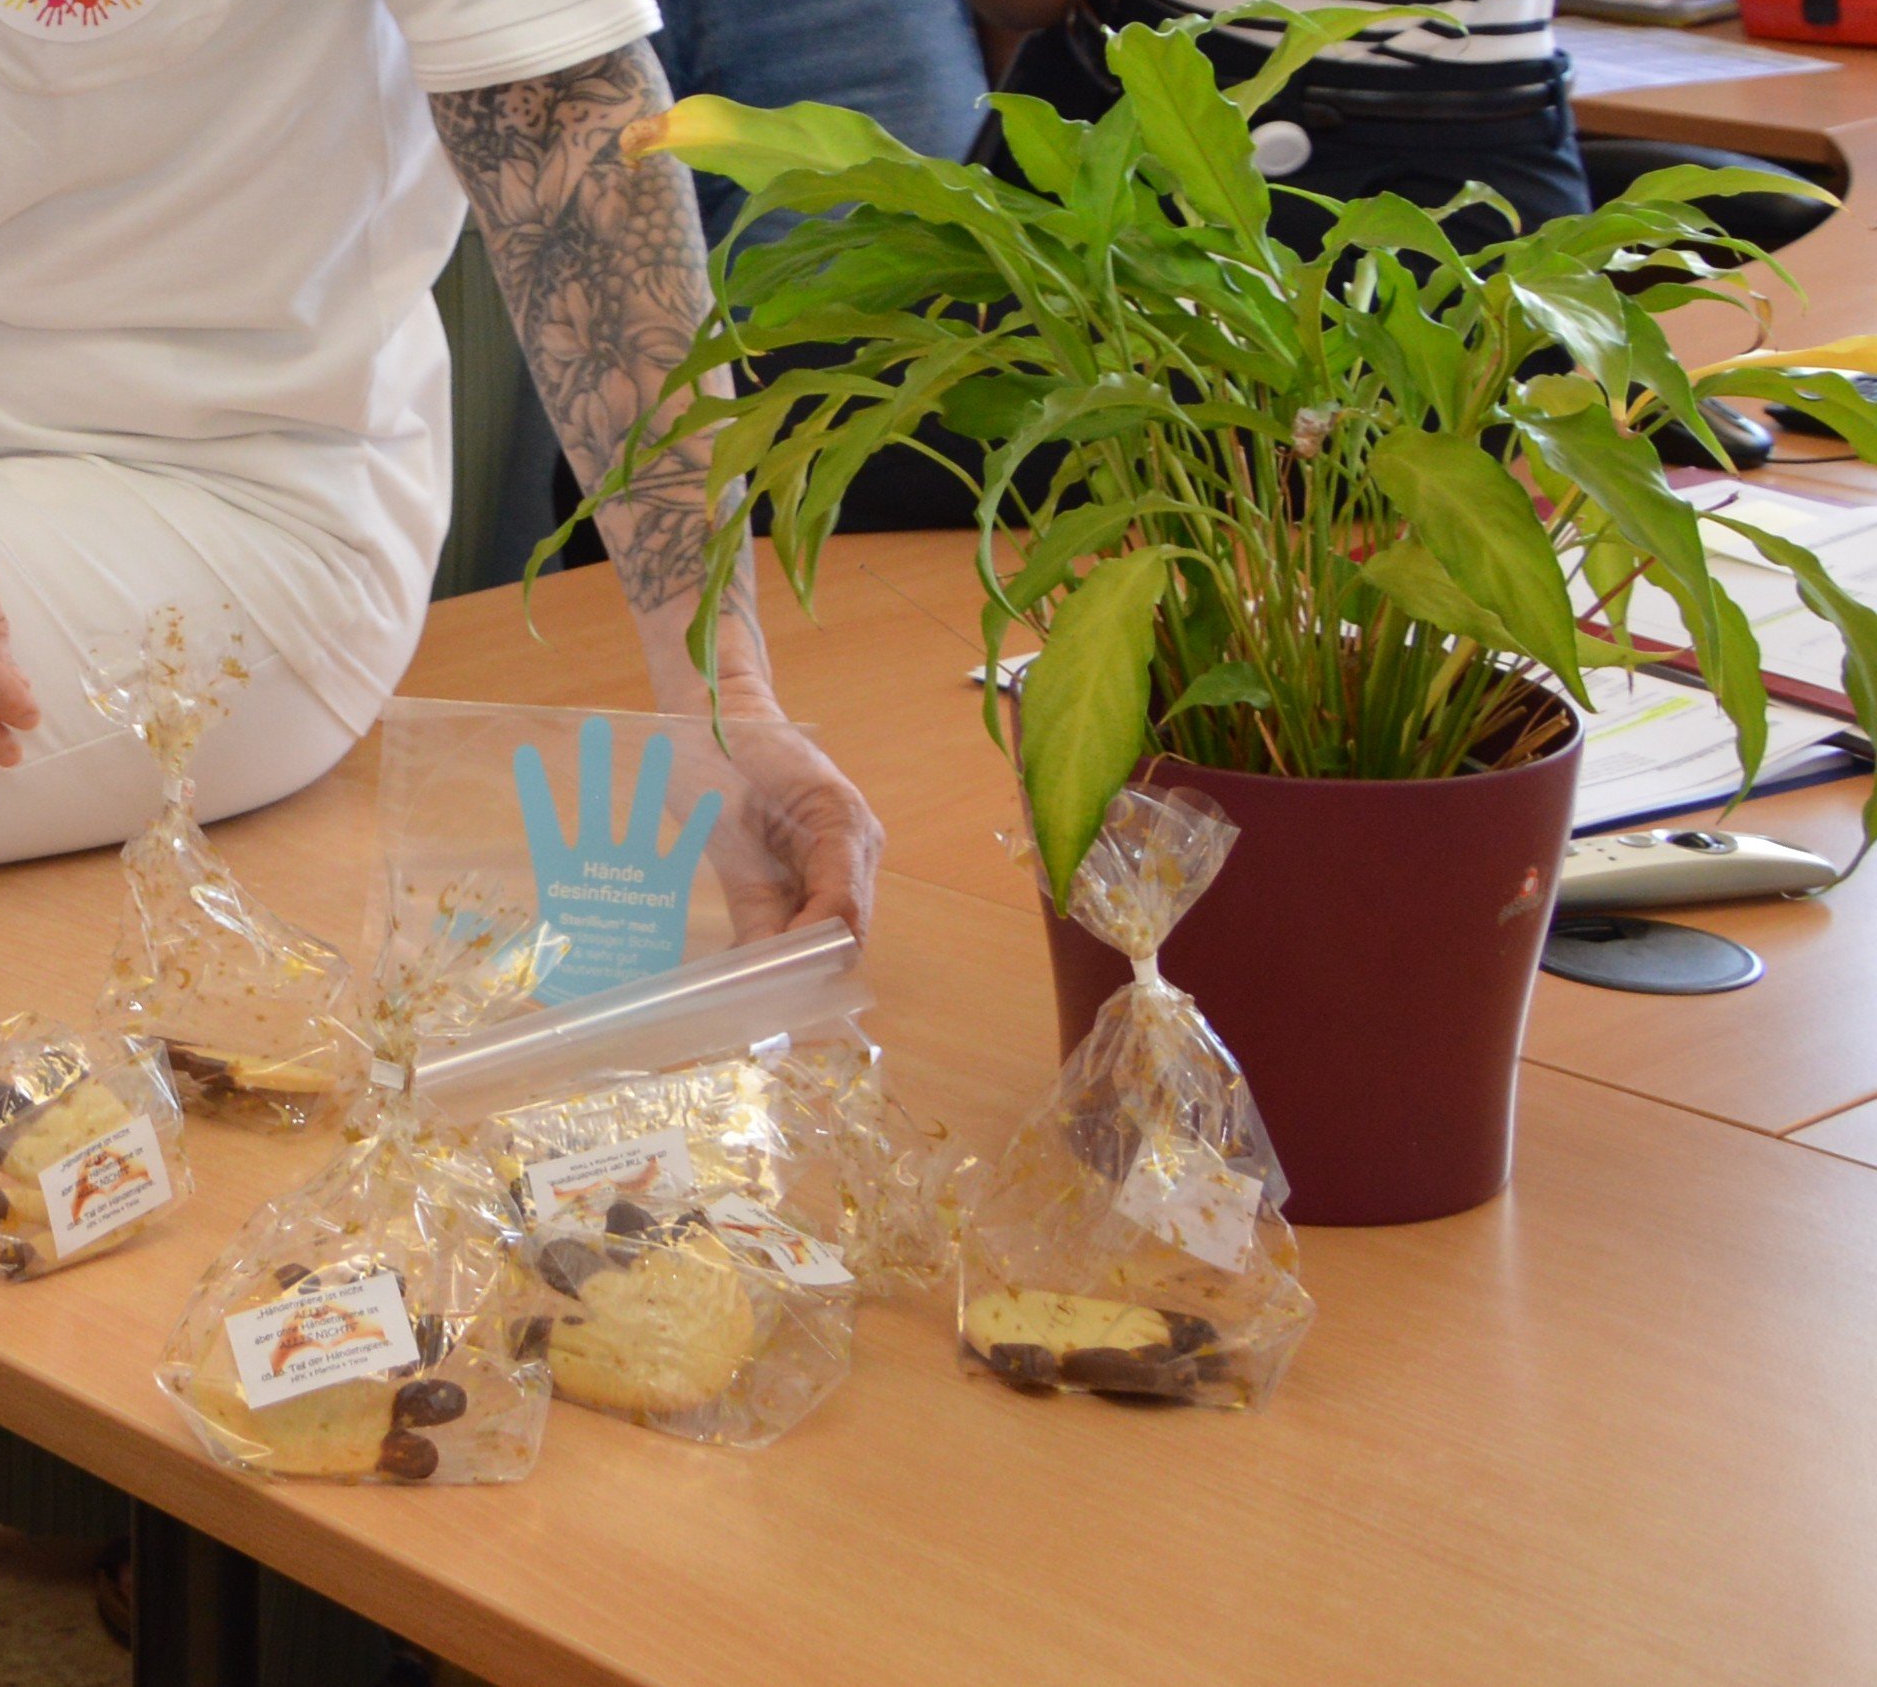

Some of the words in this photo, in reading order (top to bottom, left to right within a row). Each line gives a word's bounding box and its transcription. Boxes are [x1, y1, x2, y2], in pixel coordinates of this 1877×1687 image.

[583, 861, 644, 883] Hände
[548, 880, 677, 908] desinfizieren!
[288, 1360, 306, 1372] Tag
[307, 1355, 323, 1366] der
